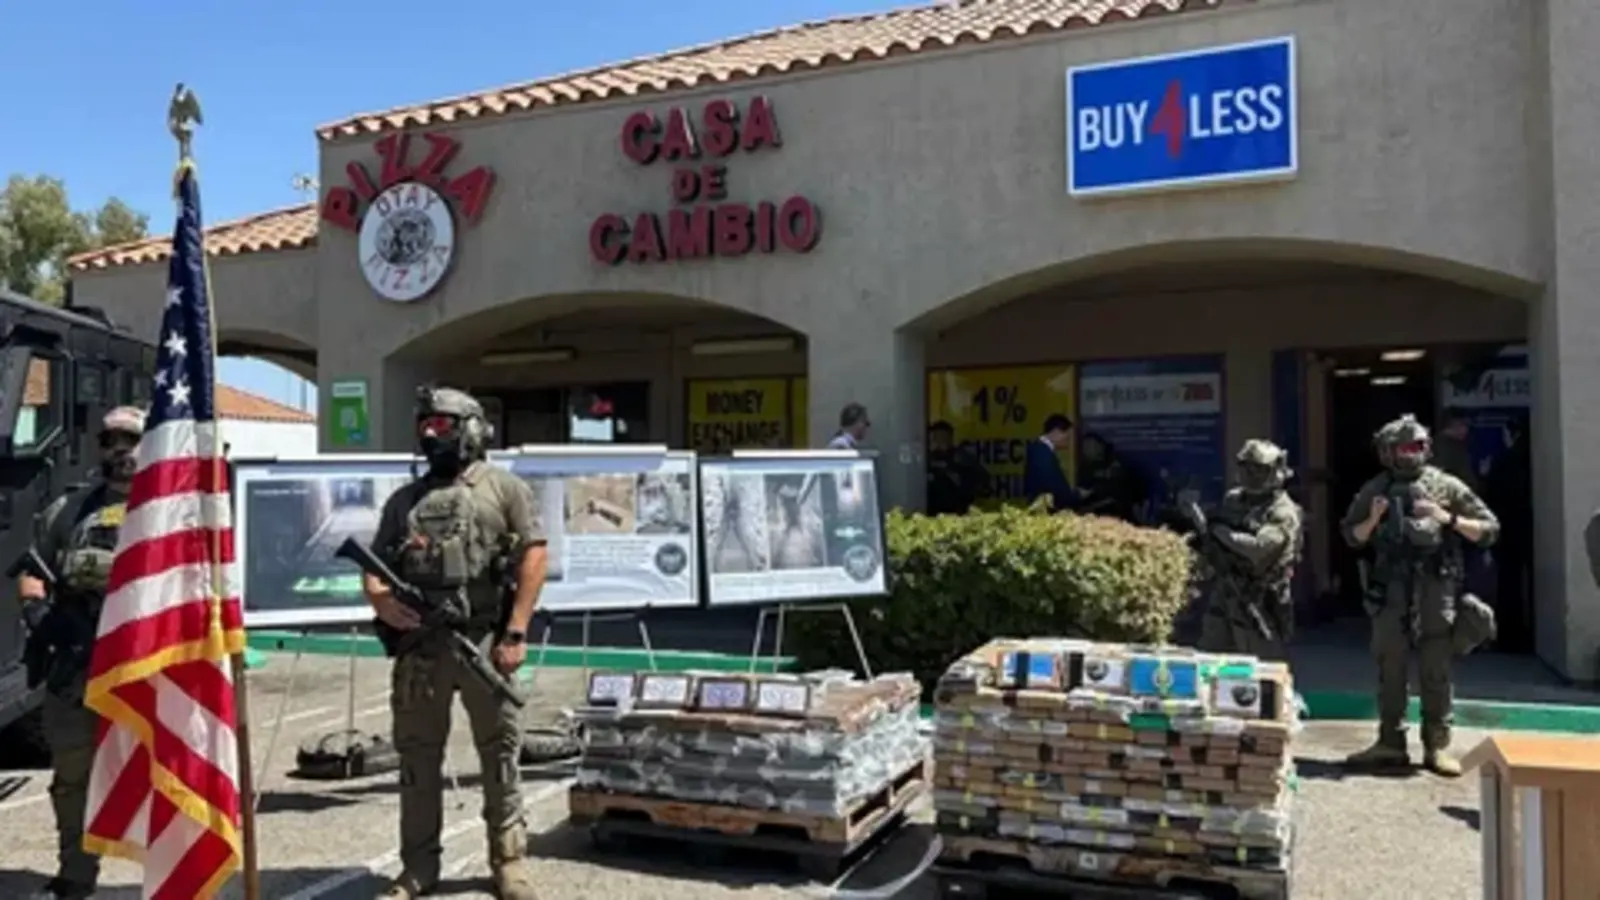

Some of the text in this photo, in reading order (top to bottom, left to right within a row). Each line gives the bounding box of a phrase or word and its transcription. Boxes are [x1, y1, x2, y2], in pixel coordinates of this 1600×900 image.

[620, 95, 781, 164] CASA
[322, 132, 497, 233] PIZZA
[673, 165, 727, 202] DE
[589, 194, 820, 266] CAMBIO
[706, 389, 764, 414] MONEY
[973, 385, 1027, 426] 1%
